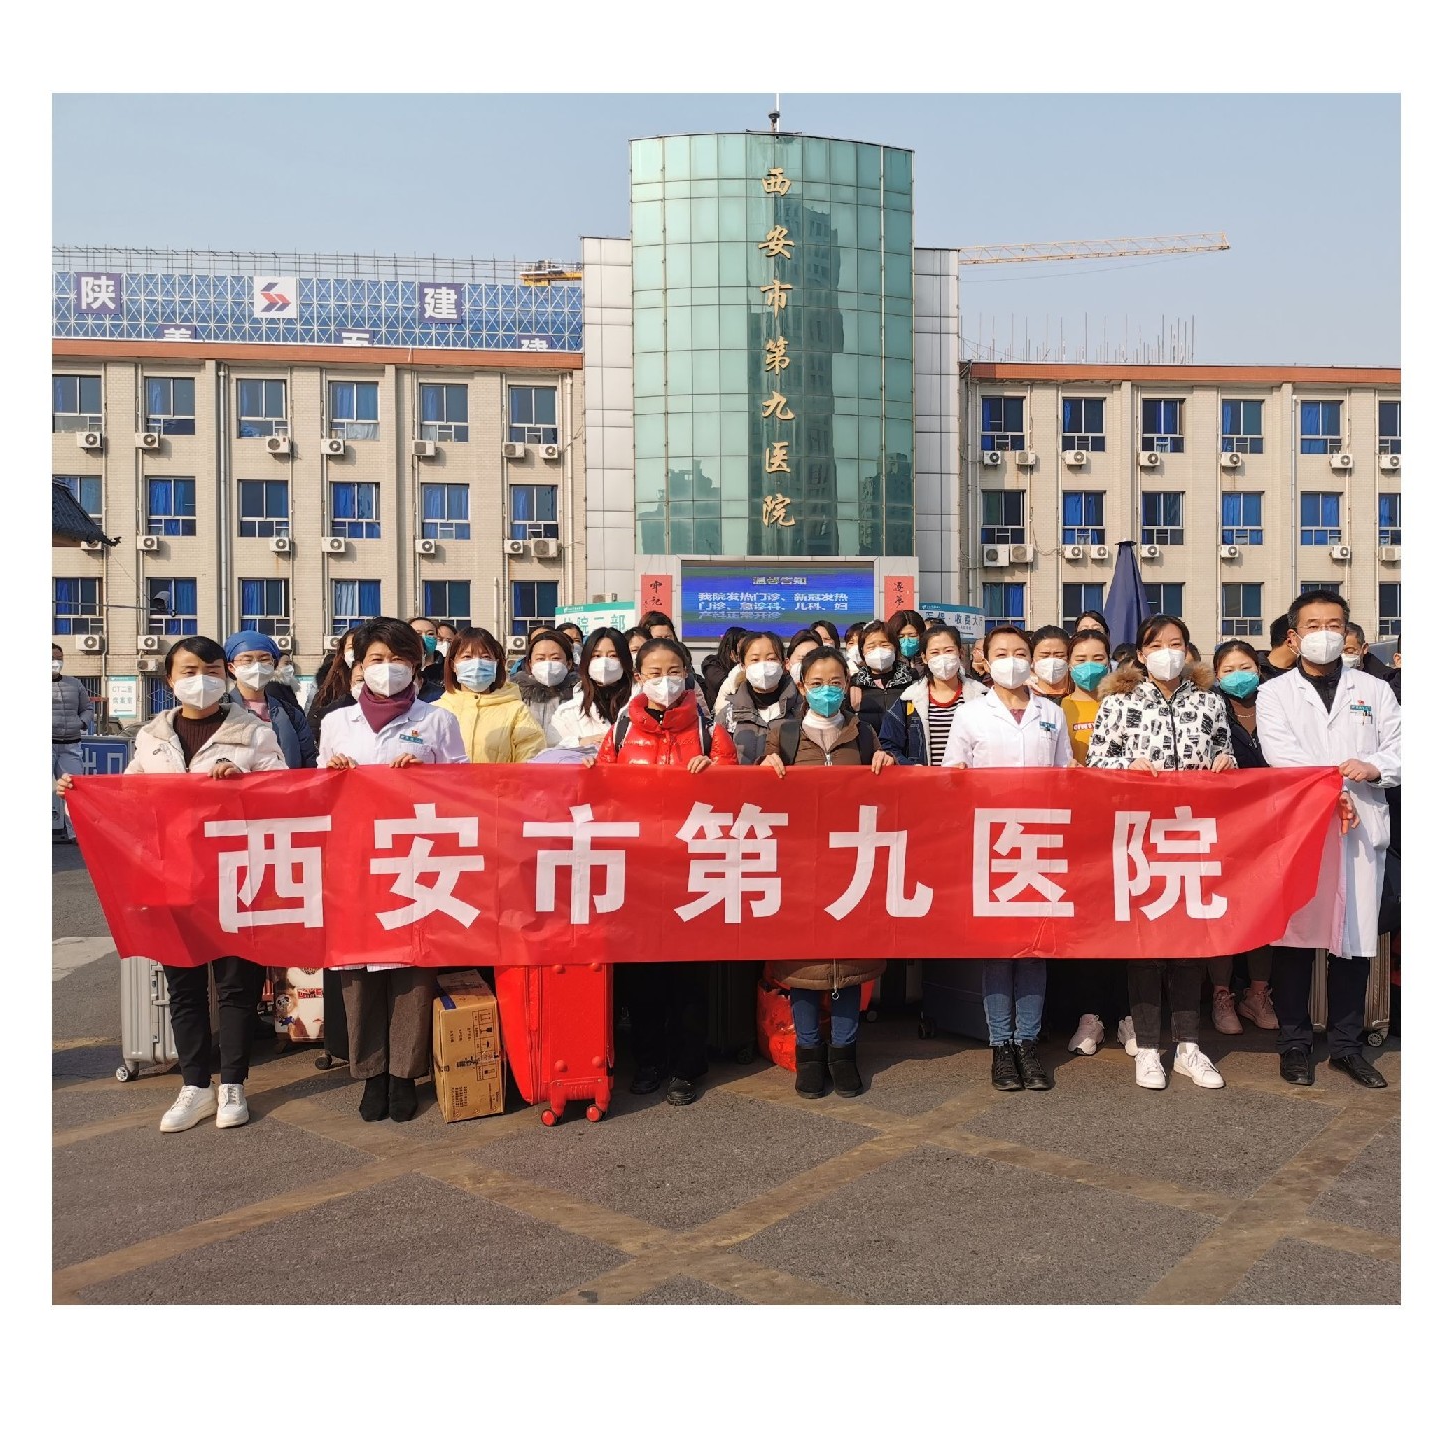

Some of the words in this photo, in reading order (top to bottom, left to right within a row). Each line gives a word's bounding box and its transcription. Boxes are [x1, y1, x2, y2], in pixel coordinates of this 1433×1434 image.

[81, 275, 116, 310] 陕
[423, 286, 458, 320] 建
[758, 168, 795, 527] 西安市第九医院
[203, 800, 1228, 934] 西安市第九医院
